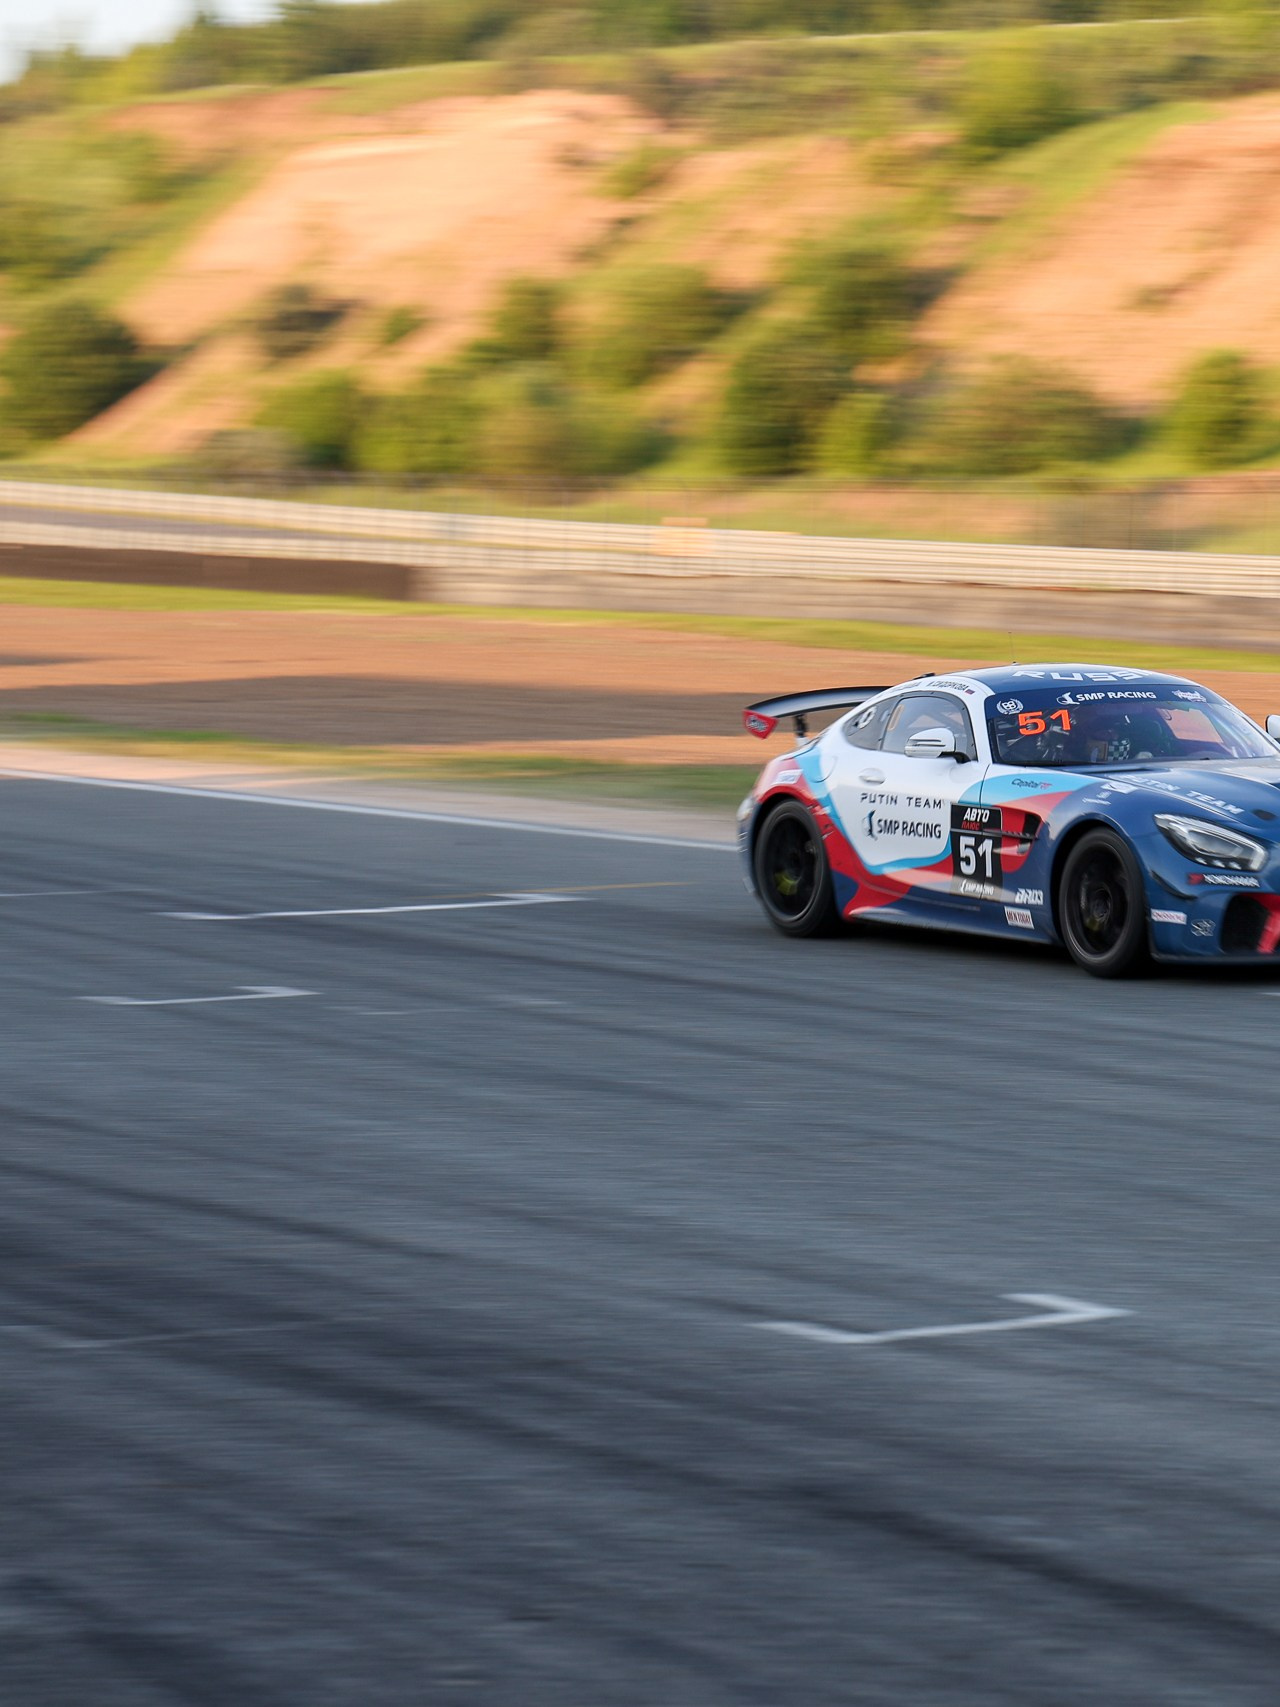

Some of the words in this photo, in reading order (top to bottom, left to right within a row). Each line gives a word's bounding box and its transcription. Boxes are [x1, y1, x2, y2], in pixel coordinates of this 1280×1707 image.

[1012, 669, 1152, 682] RUSSI
[1075, 692, 1105, 701] SMP
[1107, 691, 1157, 699] RACING
[1018, 709, 1072, 736] 51
[860, 793, 899, 805] PUTIN
[906, 796, 942, 809] TEAM
[1186, 790, 1245, 815] TEAM
[877, 819, 900, 836] SMP
[901, 821, 942, 839] RACING
[960, 836, 993, 878] 51
